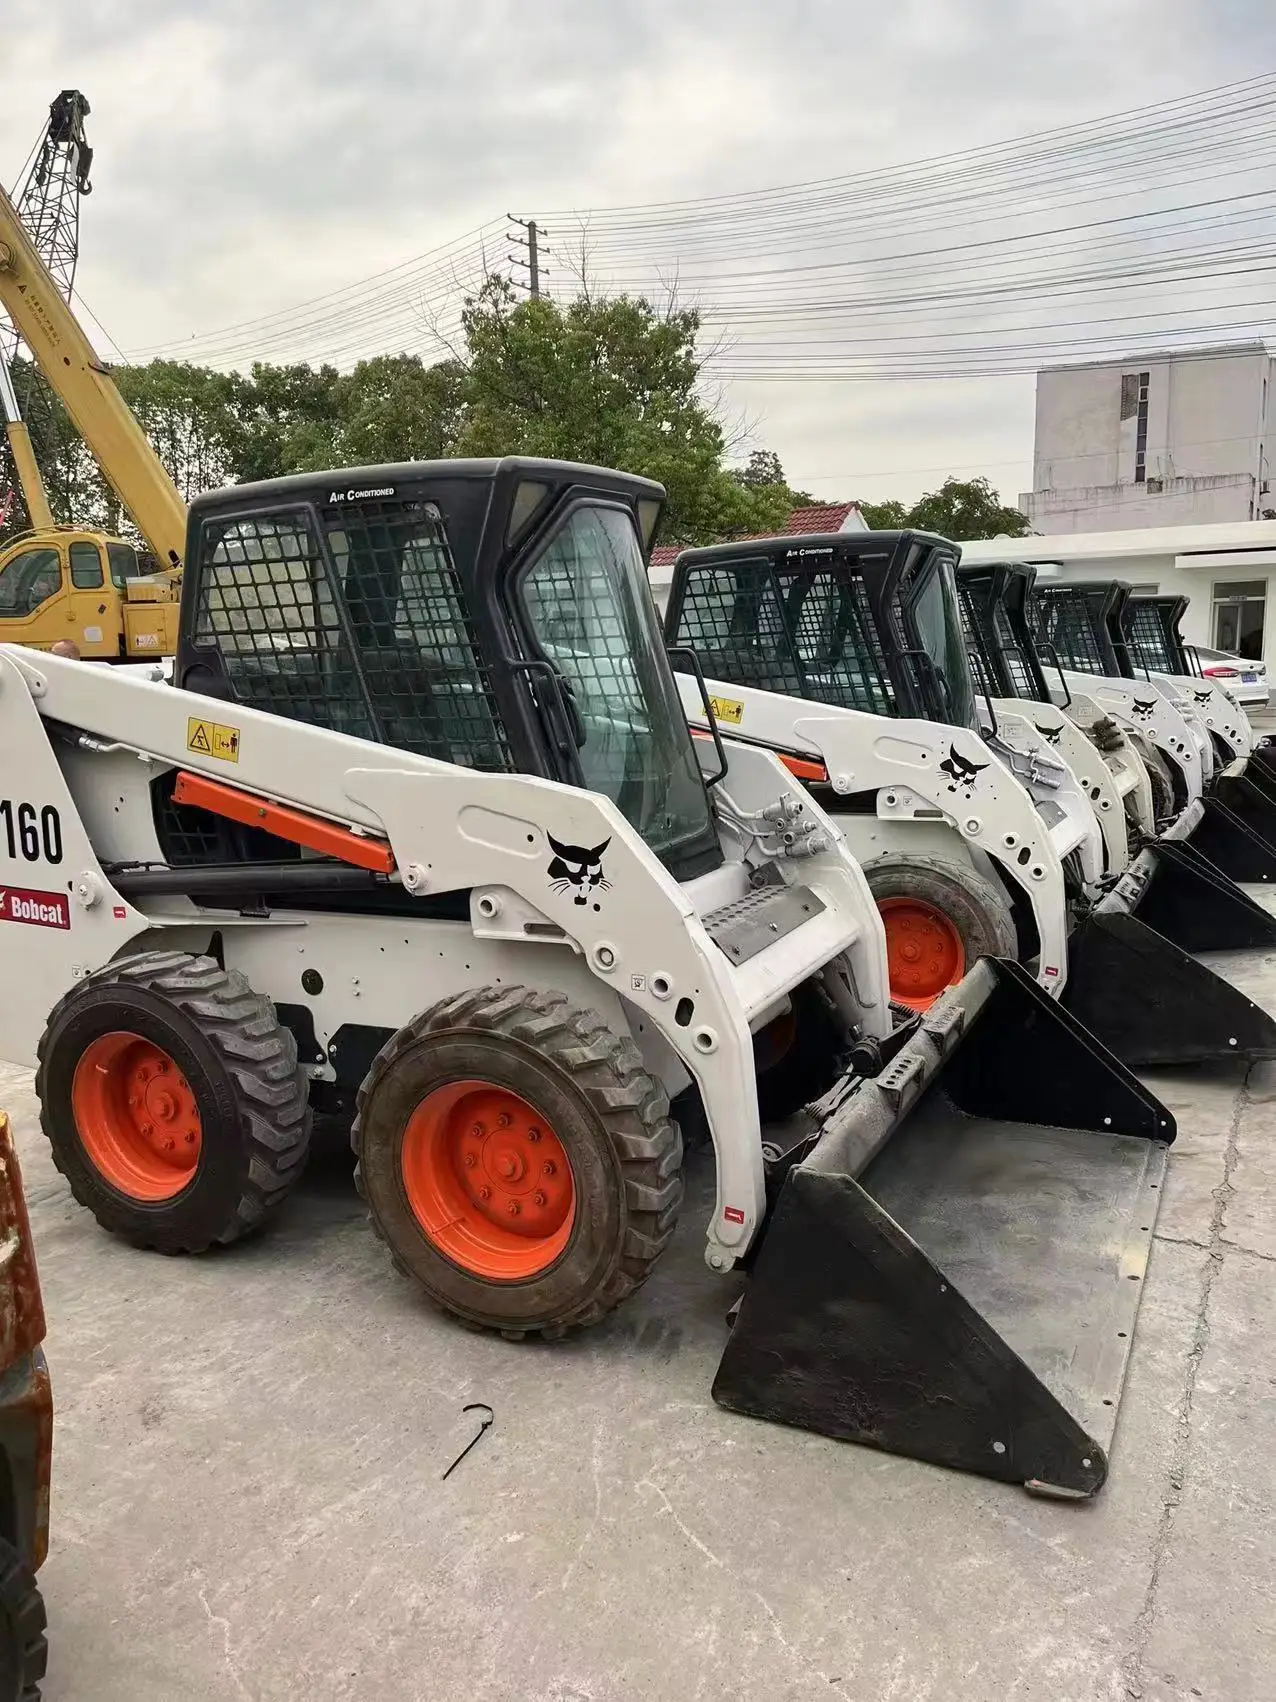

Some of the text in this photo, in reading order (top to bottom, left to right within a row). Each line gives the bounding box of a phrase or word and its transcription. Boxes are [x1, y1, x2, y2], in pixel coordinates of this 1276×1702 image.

[329, 488, 394, 503] AIR CONDITIONED
[11, 896, 63, 925] Bobcat
